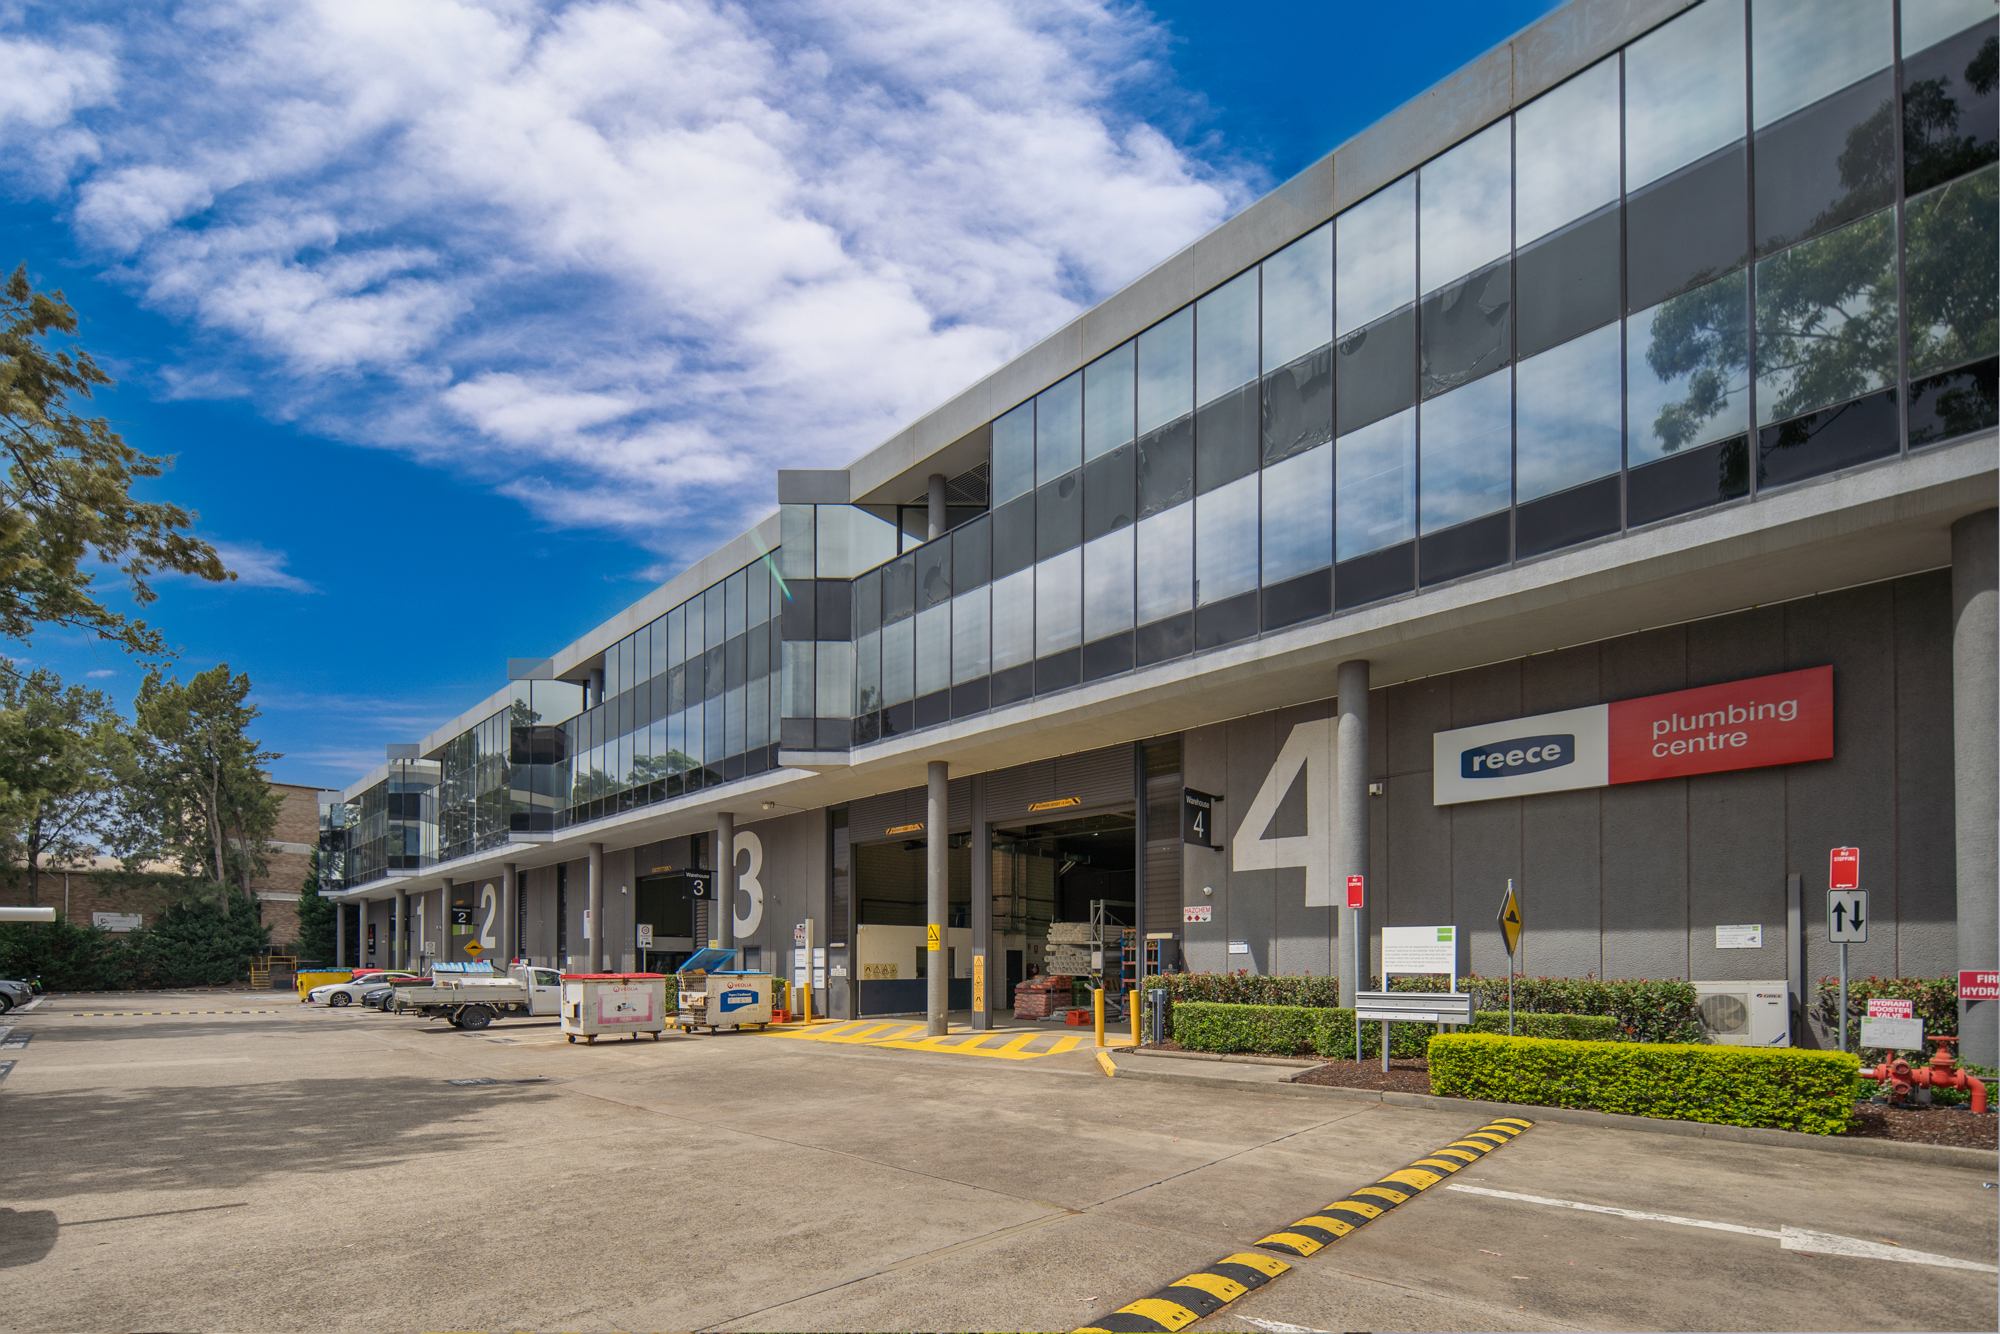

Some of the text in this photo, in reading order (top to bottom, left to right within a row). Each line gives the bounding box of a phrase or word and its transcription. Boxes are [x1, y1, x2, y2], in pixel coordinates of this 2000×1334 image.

[1652, 699, 1798, 741] plumbing
[1652, 731, 1748, 758] centre
[1472, 744, 1562, 772] reece
[1185, 794, 1210, 809] Warehouse
[1232, 715, 1339, 908] 4
[1193, 810, 1204, 838] 4
[685, 871, 710, 879] Warehouse
[733, 830, 764, 939] 3
[693, 879, 704, 896] 3
[457, 912, 467, 923] 2
[480, 883, 496, 949] 2
[1184, 906, 1211, 914] HAZCHEM
[416, 895, 425, 952] 1
[1976, 974, 1999, 984] FIR
[1869, 1000, 1911, 1008] HYDRANT
[1869, 1006, 1911, 1014] BOOSTER
